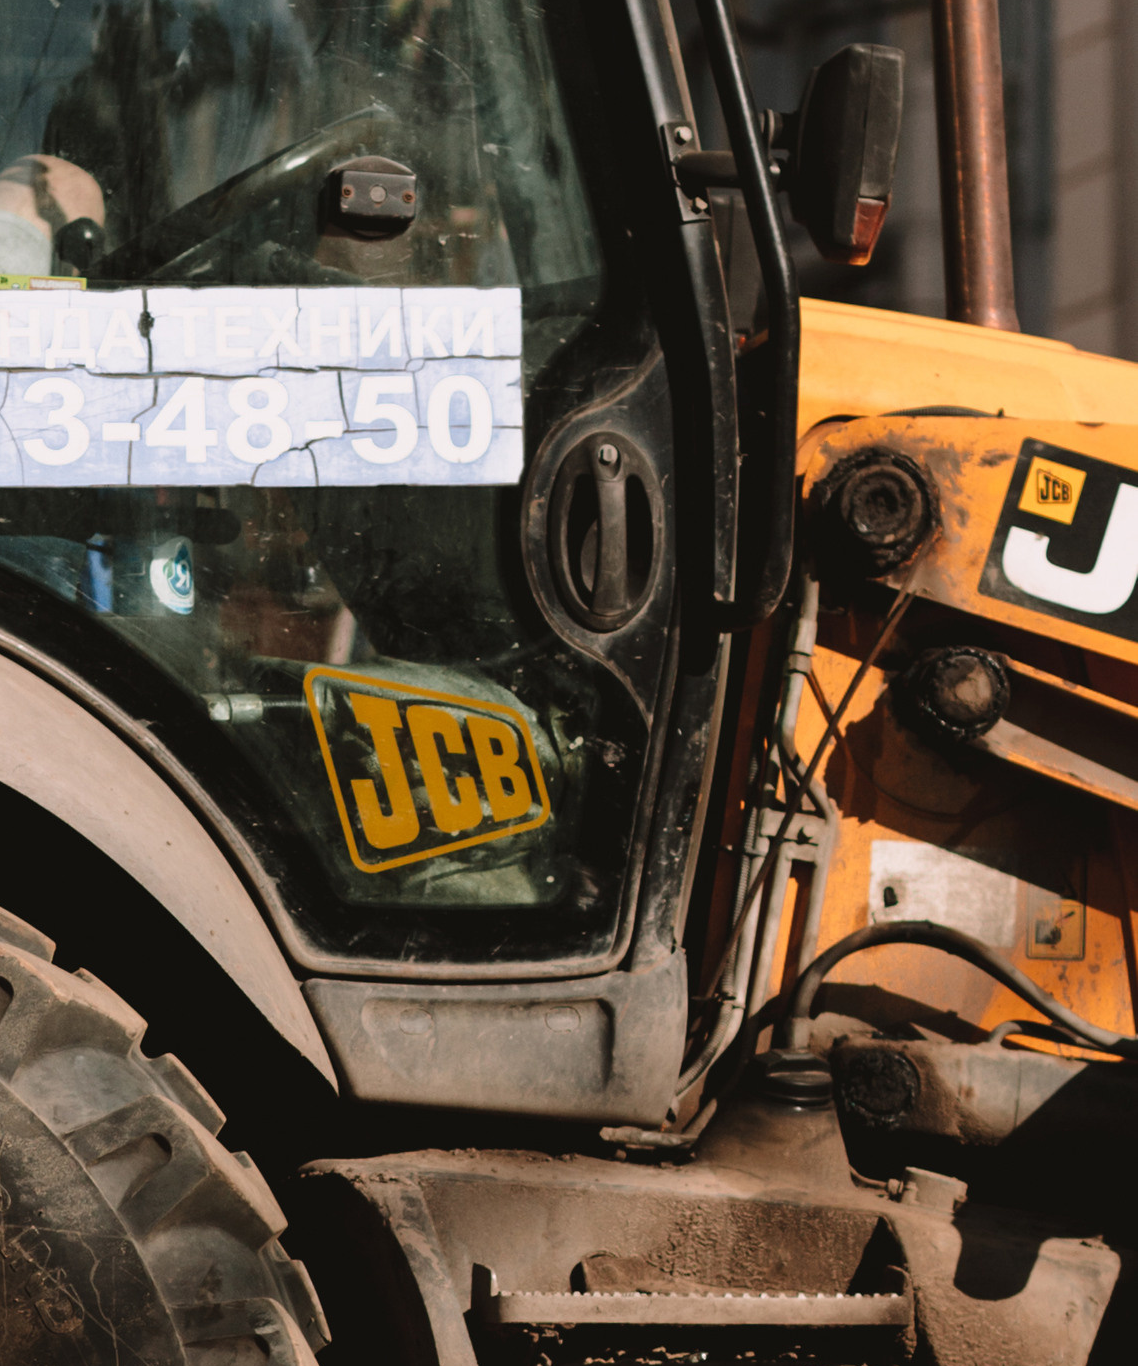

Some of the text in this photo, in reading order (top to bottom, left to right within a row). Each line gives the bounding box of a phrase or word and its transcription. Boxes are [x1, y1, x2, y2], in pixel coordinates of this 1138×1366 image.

[168, 305, 495, 358] ТЕХНИКИ
[1039, 473, 1070, 501] JCB
[348, 691, 533, 850] JCB
